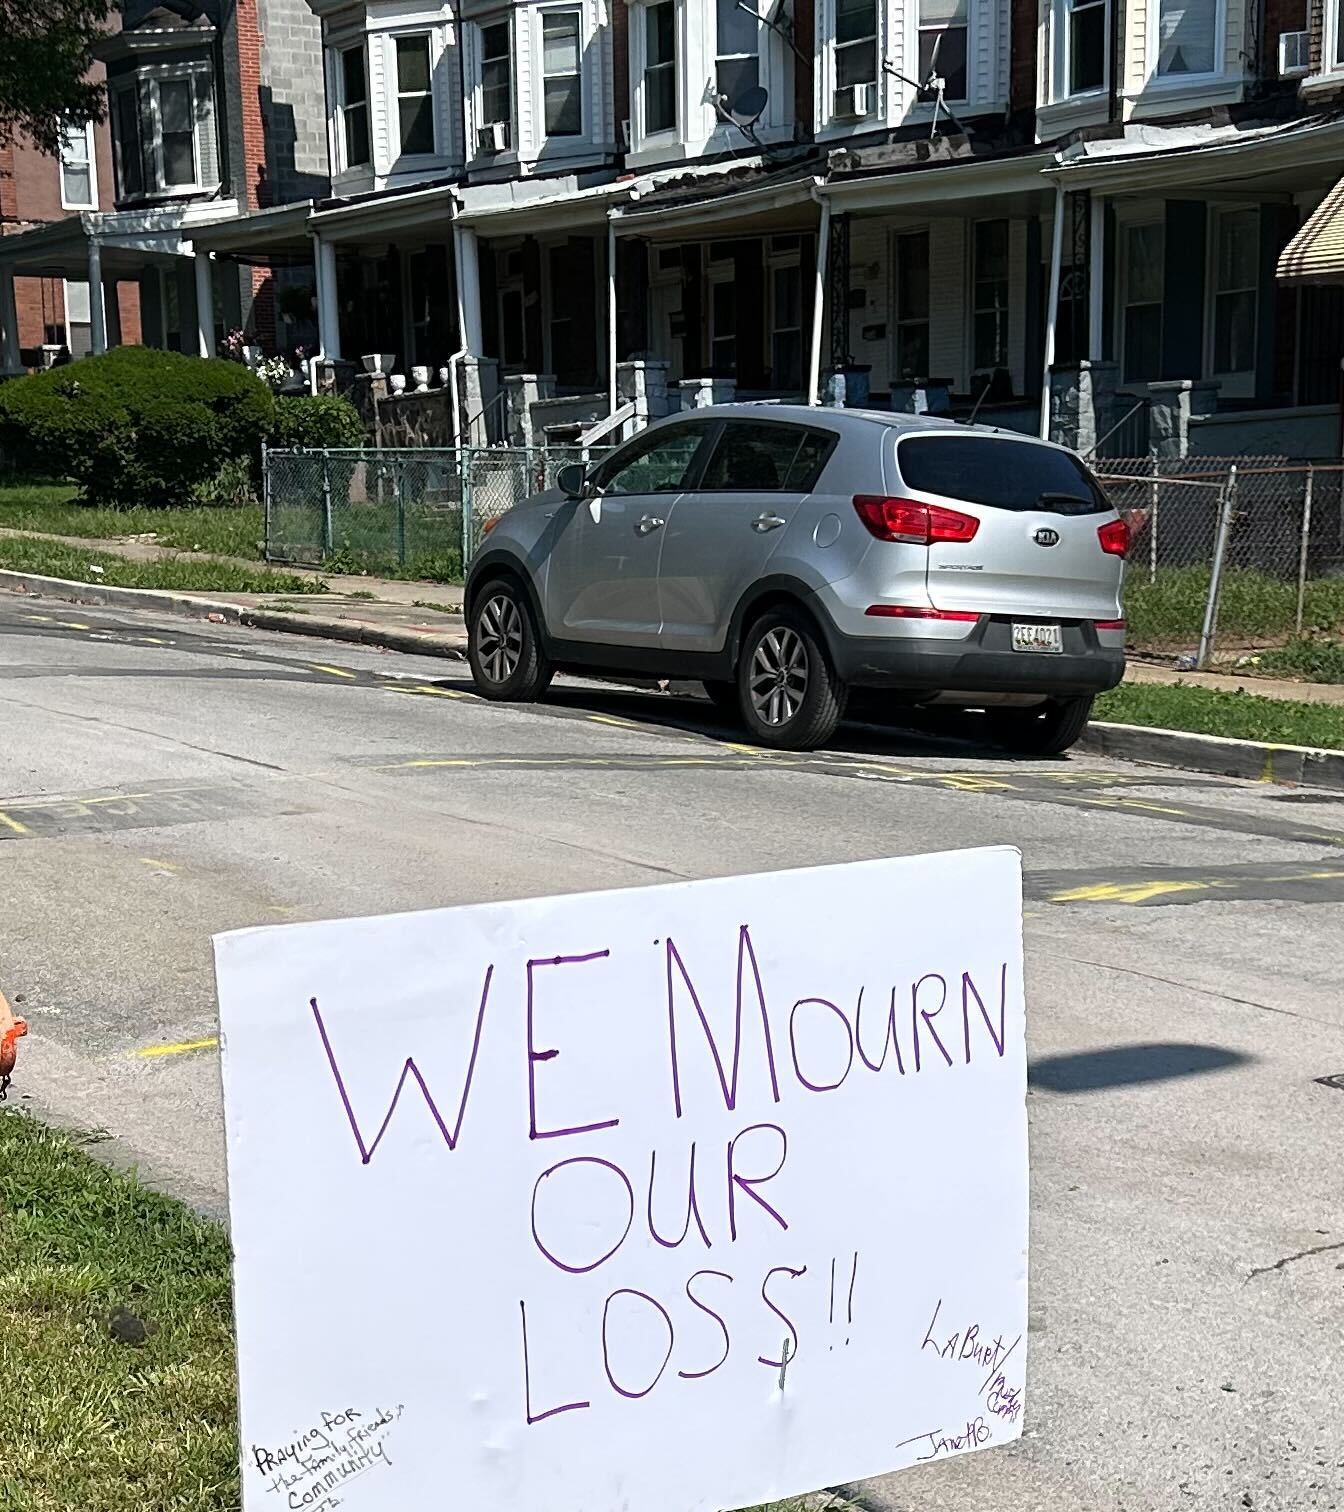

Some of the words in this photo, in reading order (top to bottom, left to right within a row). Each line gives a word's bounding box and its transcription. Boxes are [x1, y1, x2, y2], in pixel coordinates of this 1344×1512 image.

[1037, 531, 1057, 544] KIA
[309, 949, 621, 1165] WE
[663, 924, 1008, 1118] MOURN
[530, 1122, 789, 1273] OUR
[519, 1250, 859, 1425] LOSS!!
